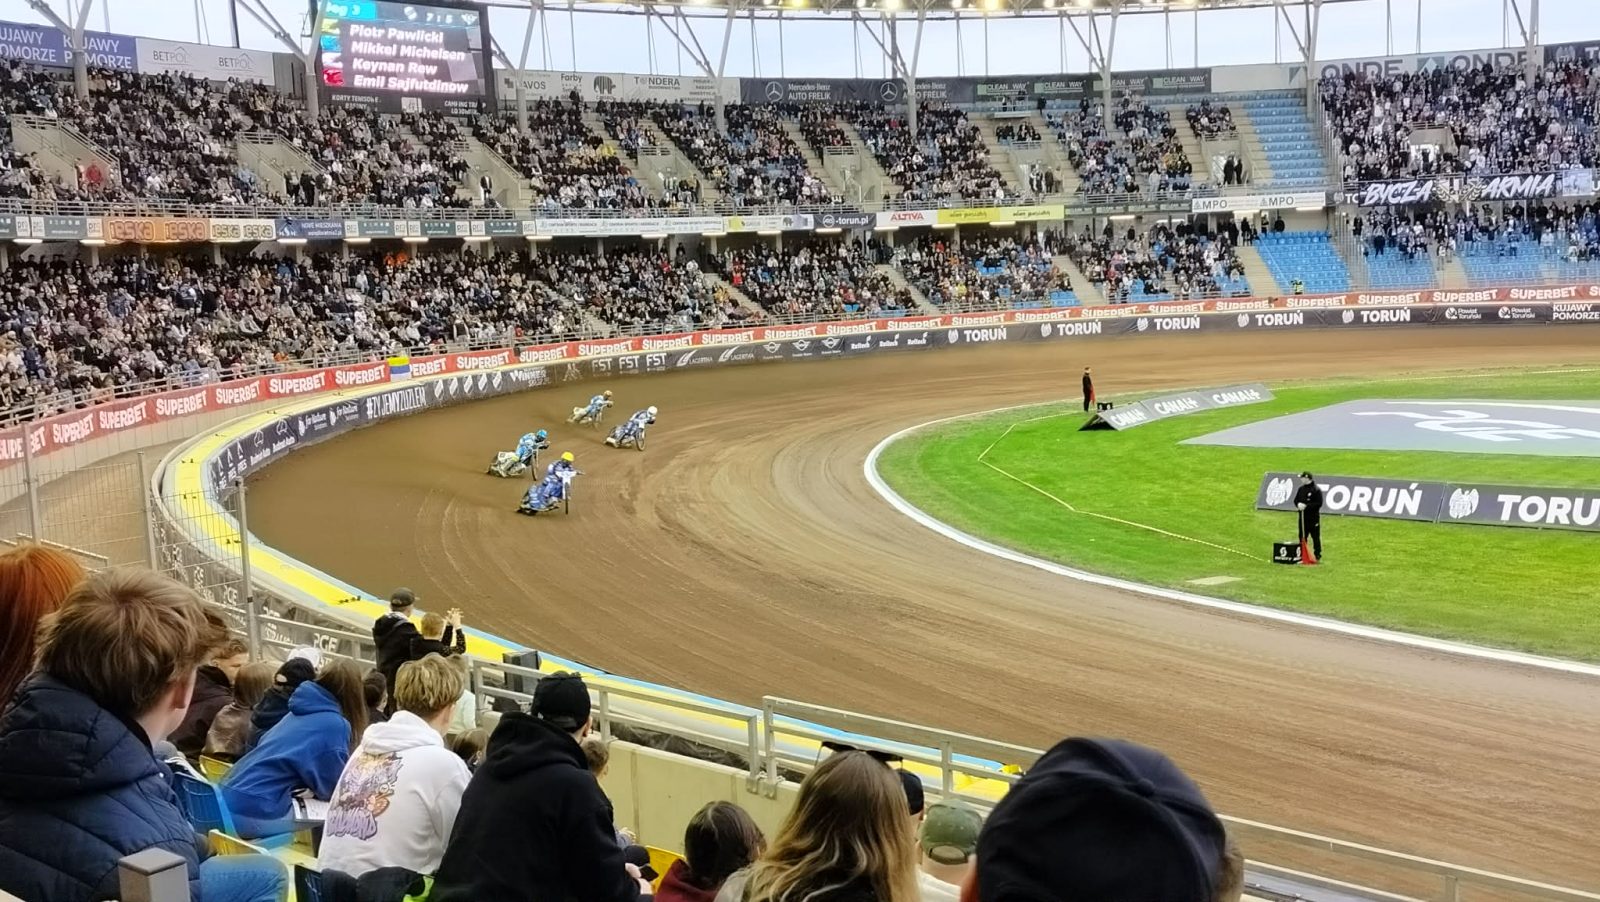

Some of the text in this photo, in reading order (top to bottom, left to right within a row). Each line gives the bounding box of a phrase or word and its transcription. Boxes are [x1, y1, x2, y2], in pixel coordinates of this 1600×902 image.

[350, 24, 444, 43] Piotr Pawlicki
[63, 34, 120, 53] KJAWY
[351, 41, 466, 61] Mikkel Michelsen
[64, 50, 132, 69] PMORZE
[353, 58, 438, 75] Keynan Rew
[354, 75, 469, 94] Emil Sajfutdinow
[808, 92, 831, 100] FRELIK
[923, 91, 948, 99] FRELIK
[1481, 173, 1556, 198] ARMIA
[1202, 200, 1228, 210] MPO
[1268, 196, 1294, 207] MPO
[890, 213, 924, 221] ALTIVA
[1358, 292, 1421, 304] SUPERBET
[1433, 289, 1498, 302] SUPERBET
[1510, 286, 1577, 299] SUPERBET
[1286, 296, 1347, 308] SUPERBET
[1553, 303, 1592, 312] KUJAWY
[1154, 313, 1201, 331] TORUŃ
[1255, 309, 1303, 326] TORUŃ
[1360, 306, 1411, 323] TORUŃ
[1553, 311, 1600, 320] POMORZE
[964, 325, 1007, 342] TORUŃ
[1057, 319, 1101, 336] TORUŃ
[578, 340, 633, 356] SUPERBET
[642, 335, 693, 350] SUPERBET
[457, 351, 510, 369] SUPERBET
[519, 345, 568, 363] SUPERBET
[619, 356, 640, 369] FST
[646, 352, 667, 366] FST
[592, 358, 612, 370] FST
[269, 372, 326, 394] SUPERBET
[335, 364, 386, 385] SUPERBET
[216, 381, 260, 405] SUPERBET
[1212, 389, 1262, 404] CANAL+
[156, 391, 207, 416] SUPERBET
[1153, 397, 1200, 415] CANAL+
[99, 402, 147, 429] SUPERBET
[53, 413, 94, 443] SUPERBET
